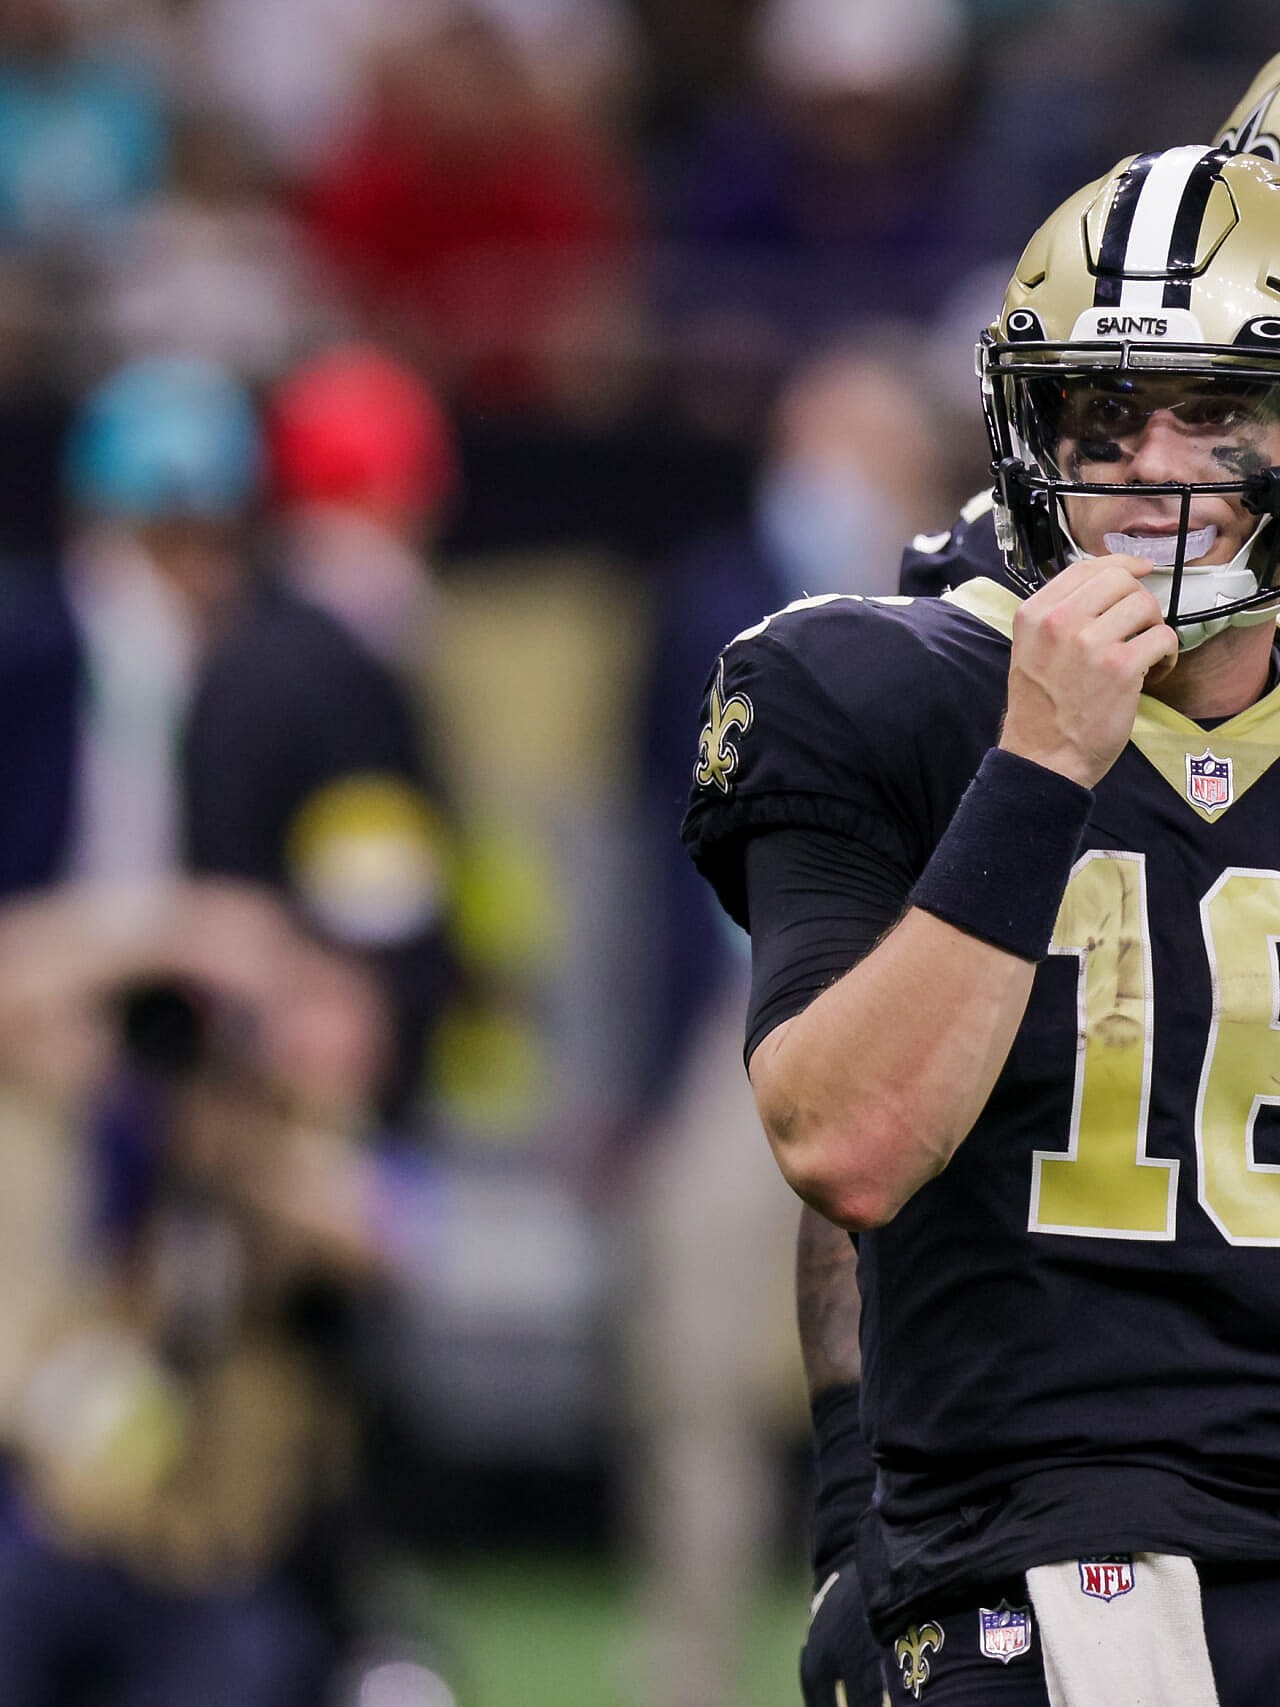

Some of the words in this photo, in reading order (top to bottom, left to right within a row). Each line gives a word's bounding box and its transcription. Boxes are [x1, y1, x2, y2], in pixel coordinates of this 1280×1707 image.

[1096, 316, 1168, 337] SAINTS
[1193, 776, 1227, 802] NFL
[1083, 1565, 1130, 1595] NFL
[986, 1629, 1024, 1652] NFL
